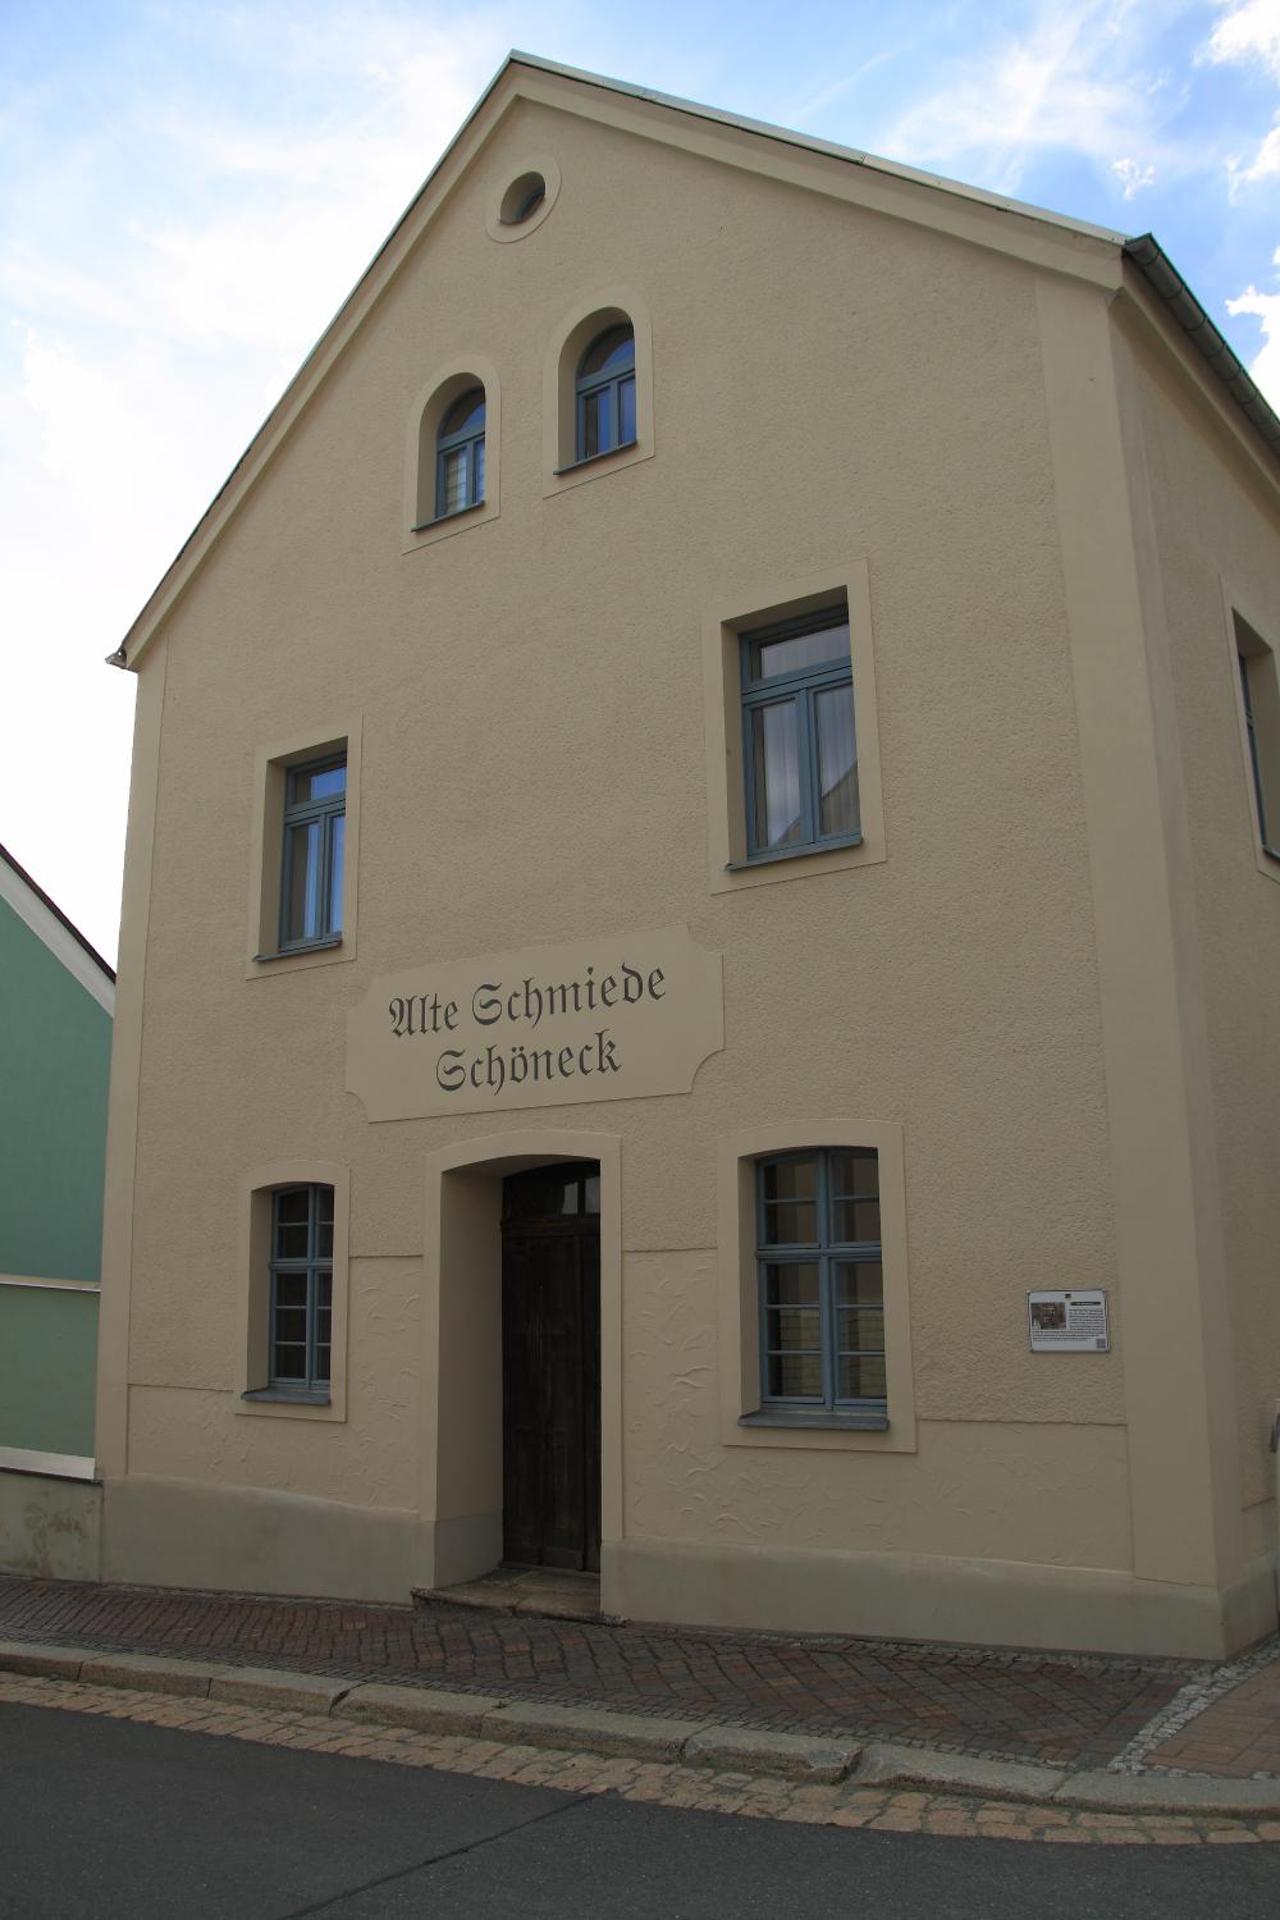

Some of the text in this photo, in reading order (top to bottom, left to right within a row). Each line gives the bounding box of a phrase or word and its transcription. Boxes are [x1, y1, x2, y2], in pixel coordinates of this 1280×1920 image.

[389, 962, 667, 1037] Alte Schmiede
[435, 1029, 622, 1096] Schöneck
